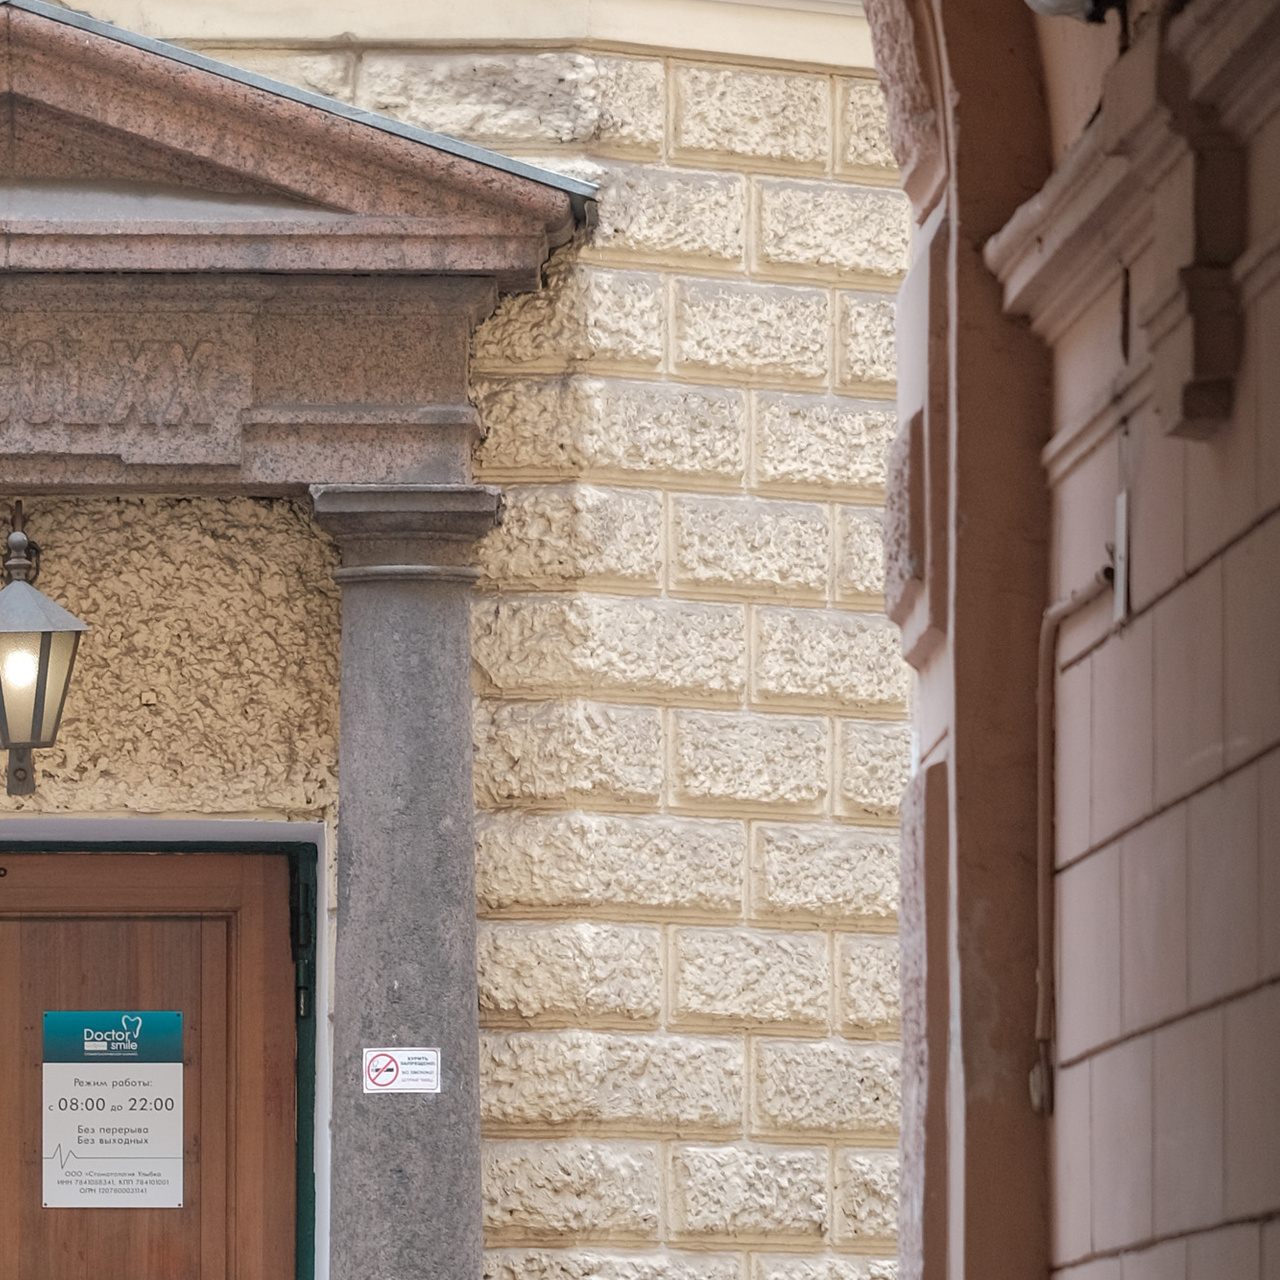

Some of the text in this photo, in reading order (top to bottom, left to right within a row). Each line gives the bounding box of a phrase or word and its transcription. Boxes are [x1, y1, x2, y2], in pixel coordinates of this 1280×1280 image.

[83, 1028, 131, 1041] Doctor
[110, 1039, 138, 1050] smile
[73, 1078, 153, 1089] Режим работы:
[58, 1097, 106, 1111] 08:00
[110, 1104, 123, 1112] до
[128, 1097, 175, 1111] 22:00
[77, 1125, 149, 1136] Без перерыва
[77, 1135, 149, 1146] Без выходных
